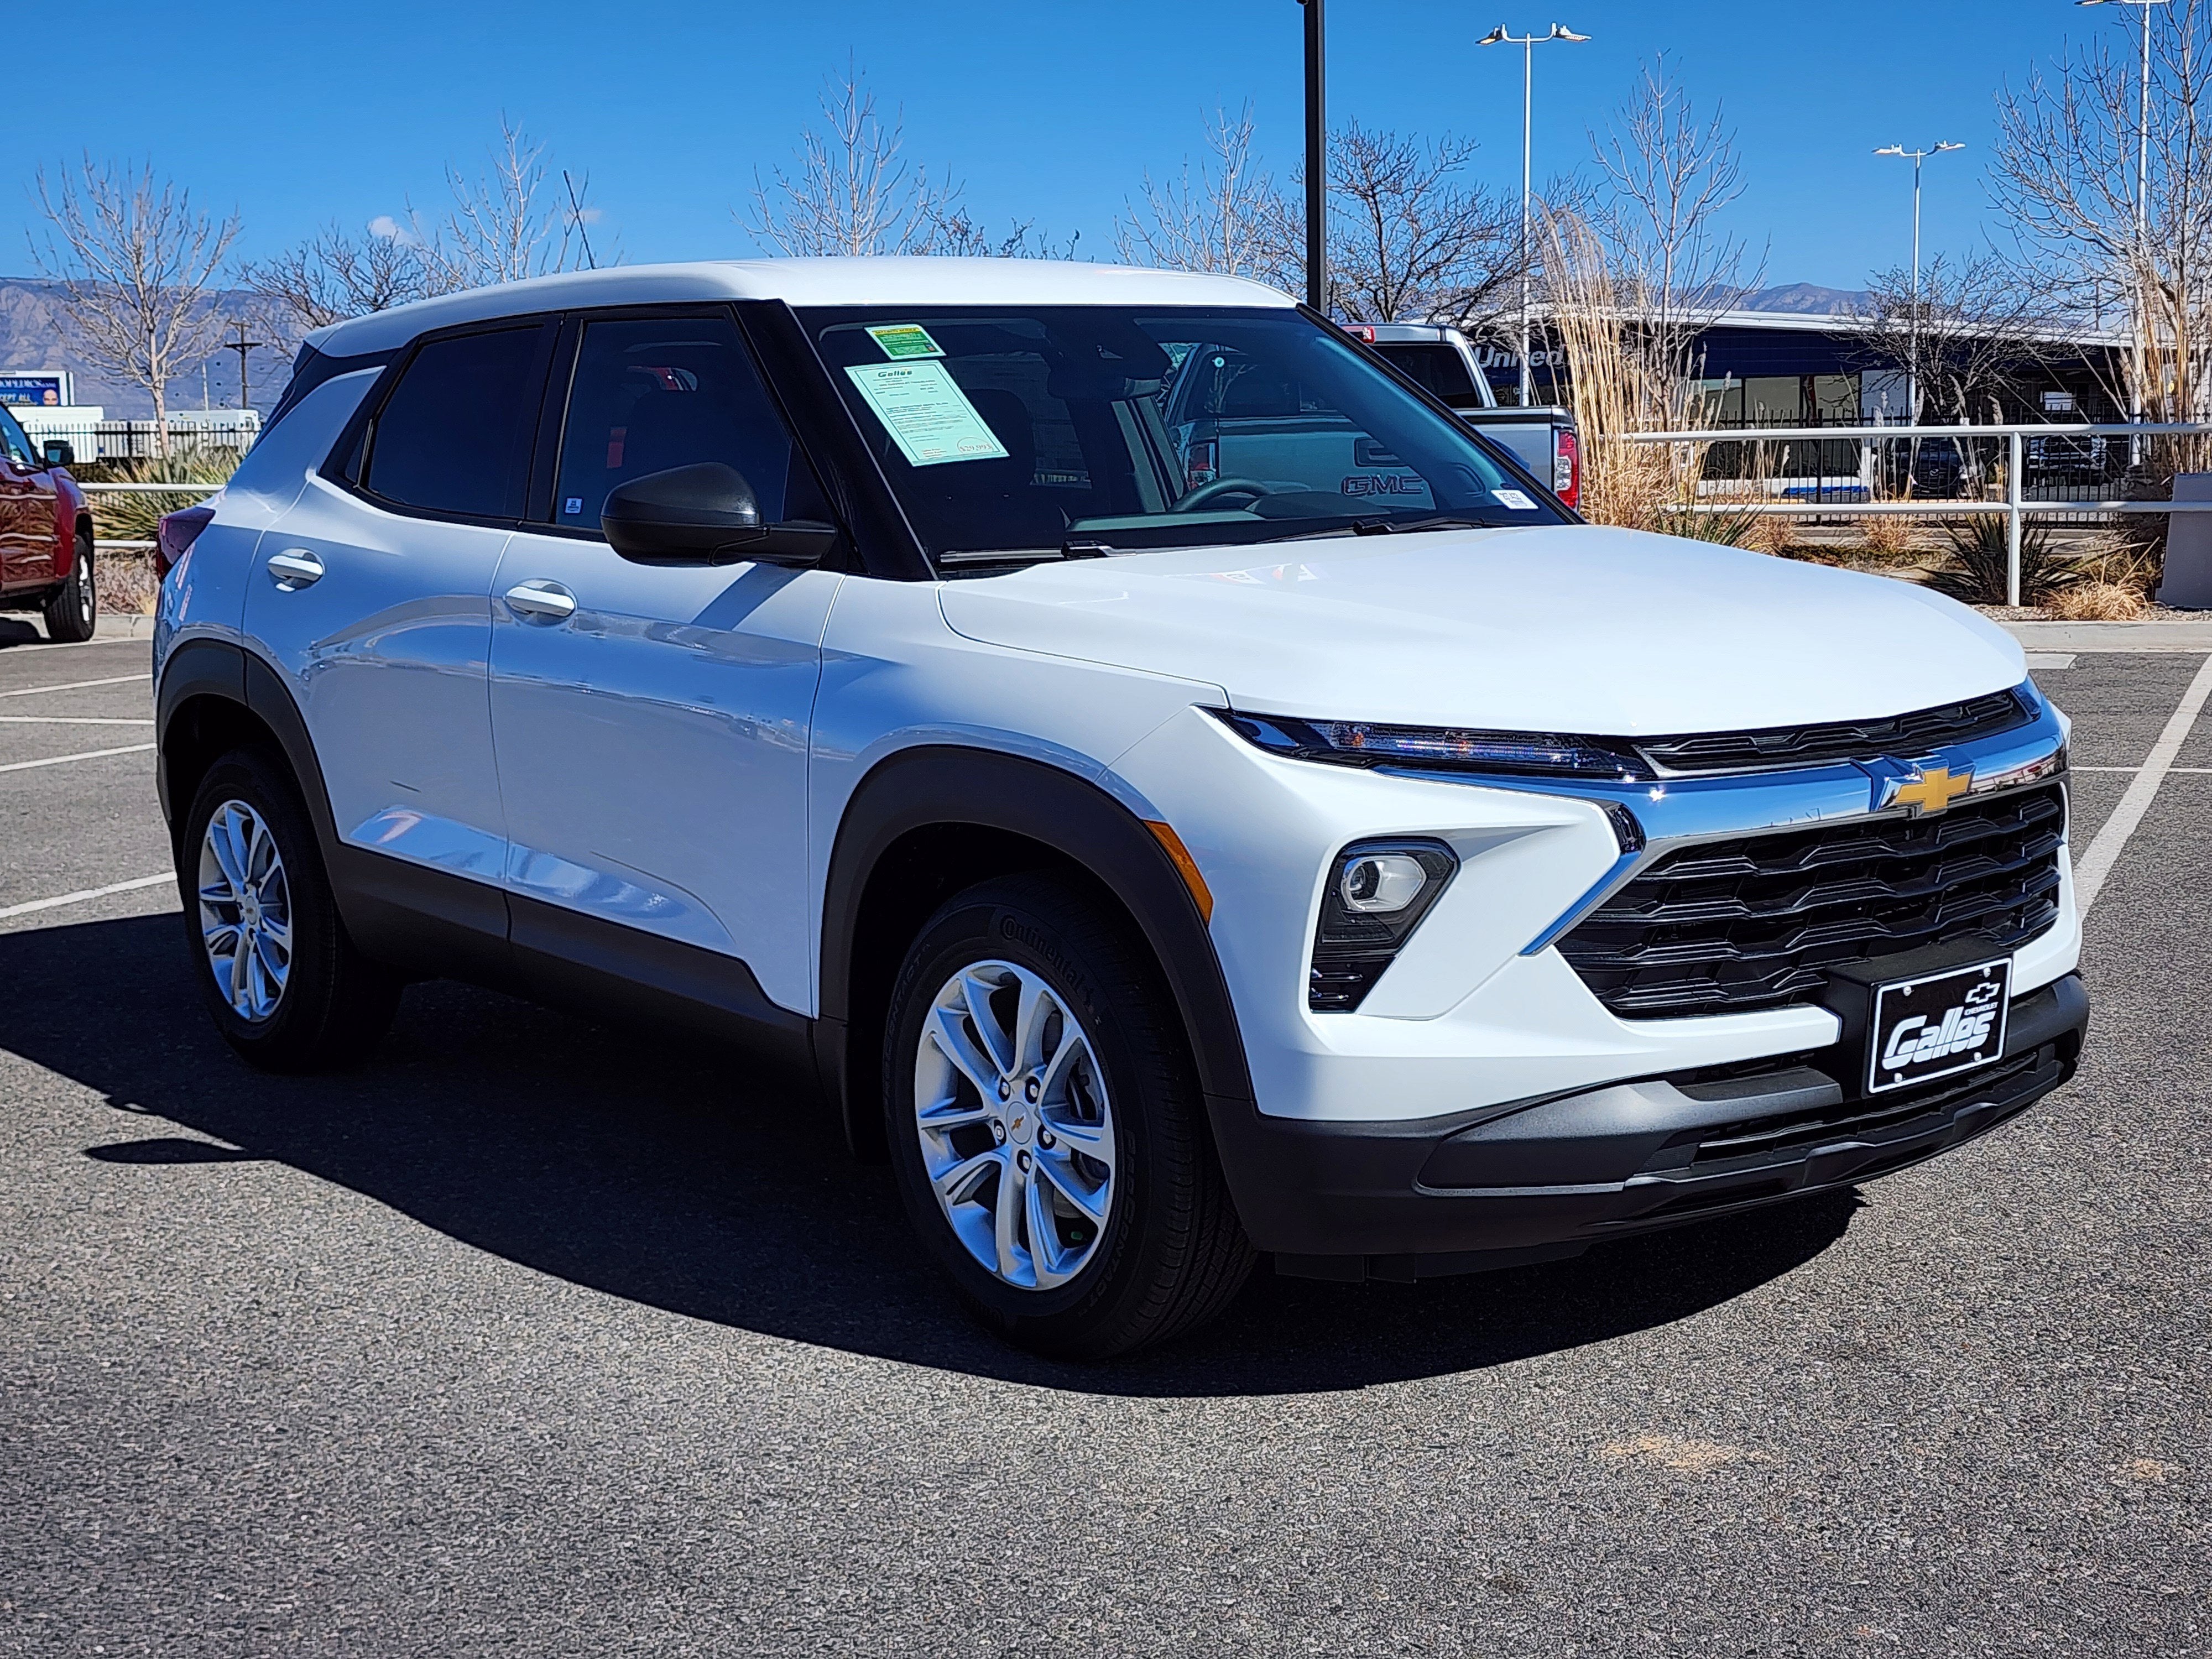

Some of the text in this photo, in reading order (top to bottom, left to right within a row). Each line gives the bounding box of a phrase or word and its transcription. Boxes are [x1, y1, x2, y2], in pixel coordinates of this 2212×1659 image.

[1474, 344, 1564, 368] Unied
[1341, 474, 1425, 495] GMC
[1881, 1006, 1996, 1070] Galles
